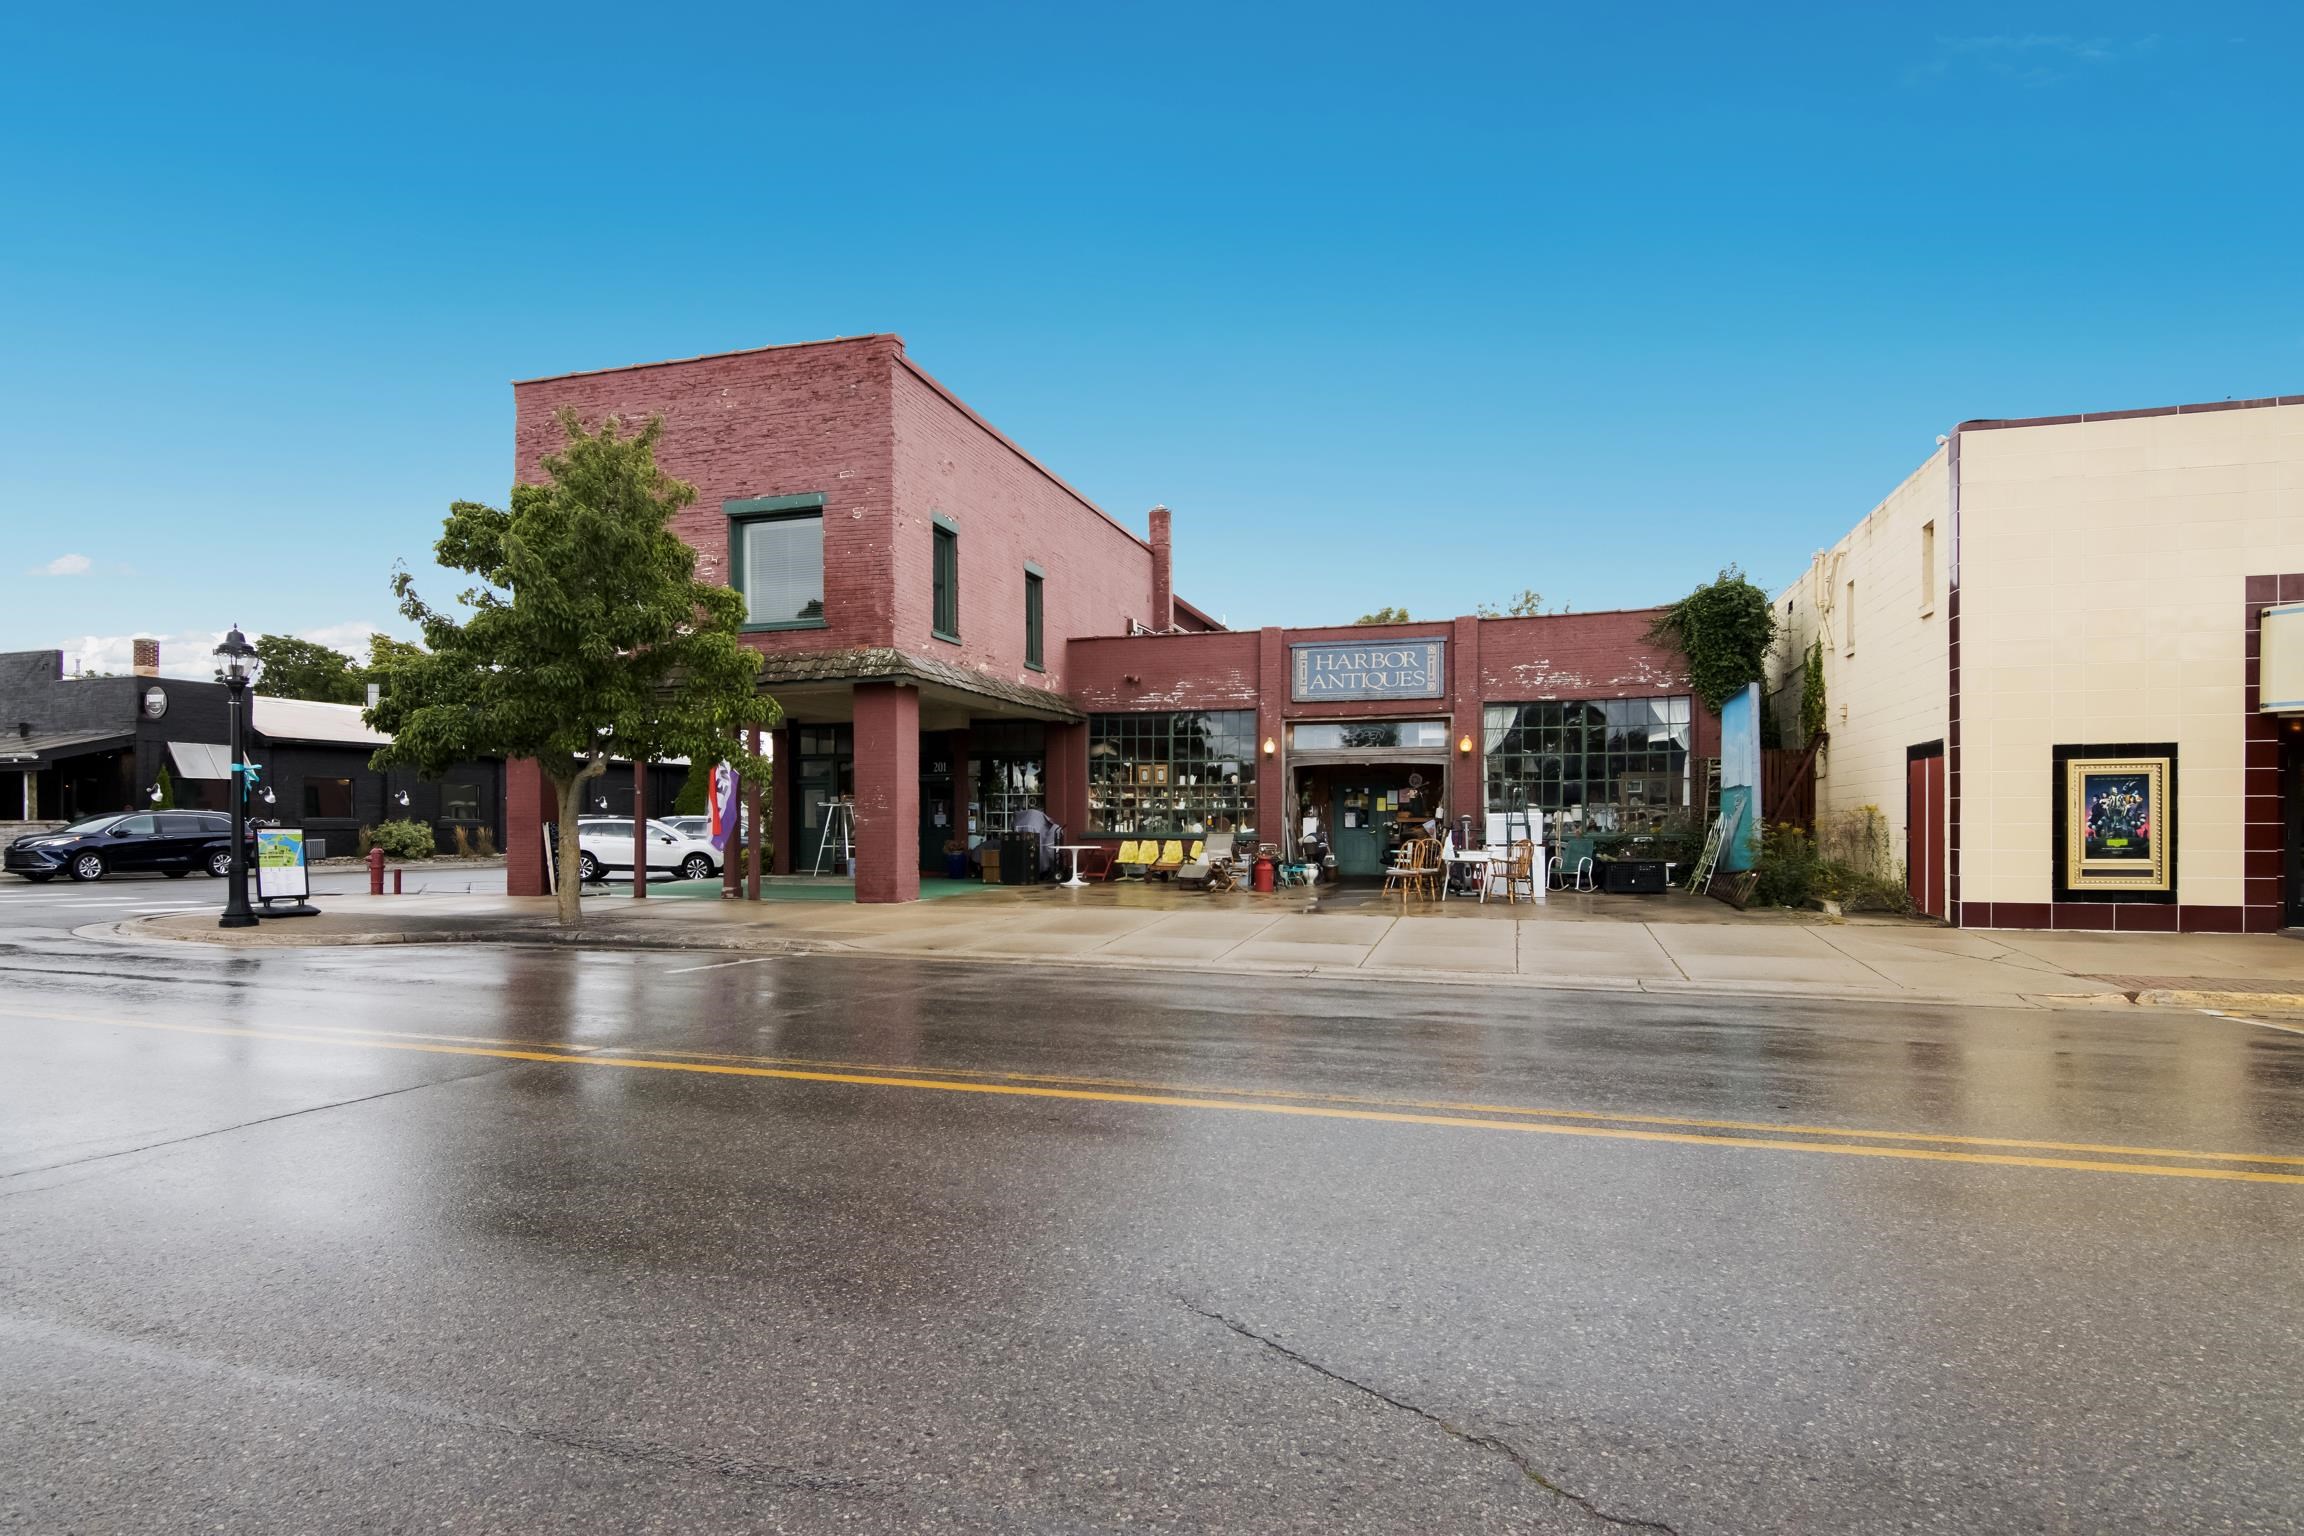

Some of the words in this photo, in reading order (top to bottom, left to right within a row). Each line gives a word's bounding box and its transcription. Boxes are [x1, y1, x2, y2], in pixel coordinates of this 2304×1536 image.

[1315, 651, 1419, 671] HARBOR
[1309, 670, 1425, 690] ANTIQUES
[1357, 730, 1385, 740] OPEN
[933, 762, 947, 773] 201
